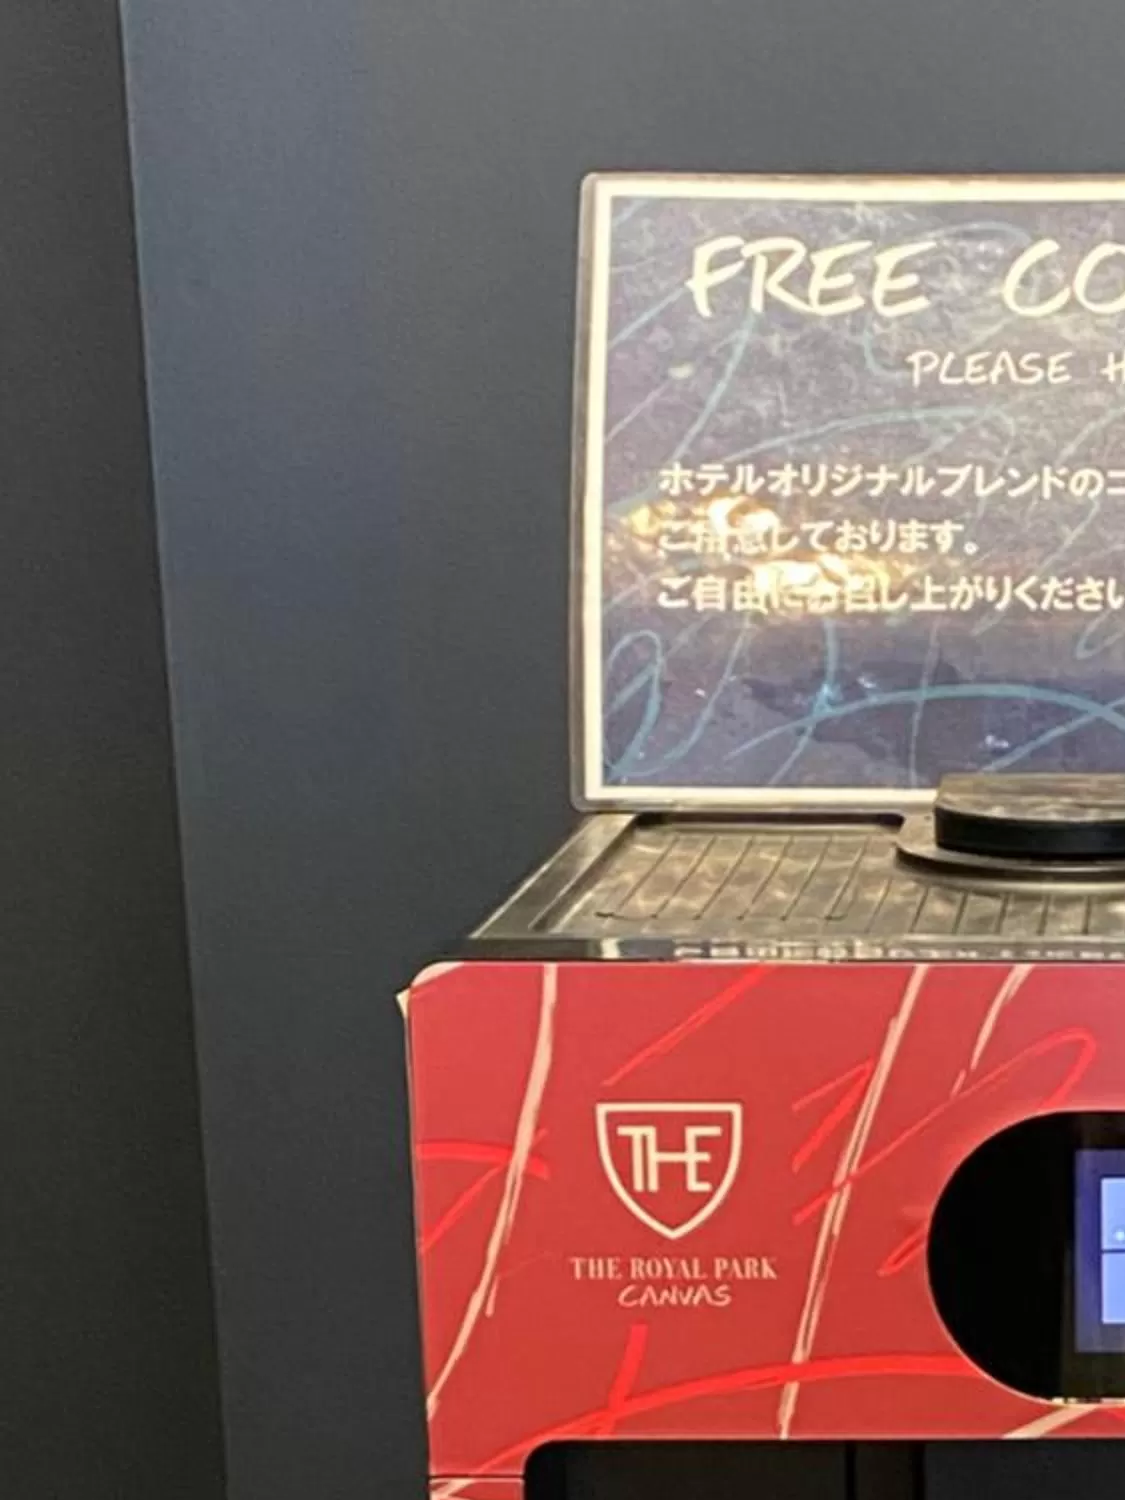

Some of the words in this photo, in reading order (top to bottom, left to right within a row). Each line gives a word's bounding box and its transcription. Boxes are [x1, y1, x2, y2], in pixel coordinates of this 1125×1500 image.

[686, 233, 940, 320] FREE
[906, 349, 1073, 388] PLEASE
[616, 1125, 723, 1192] THE
[569, 1256, 623, 1281] THE
[629, 1256, 708, 1281] ROYAL
[714, 1256, 778, 1281] PARK
[617, 1283, 733, 1308] CANVAS
